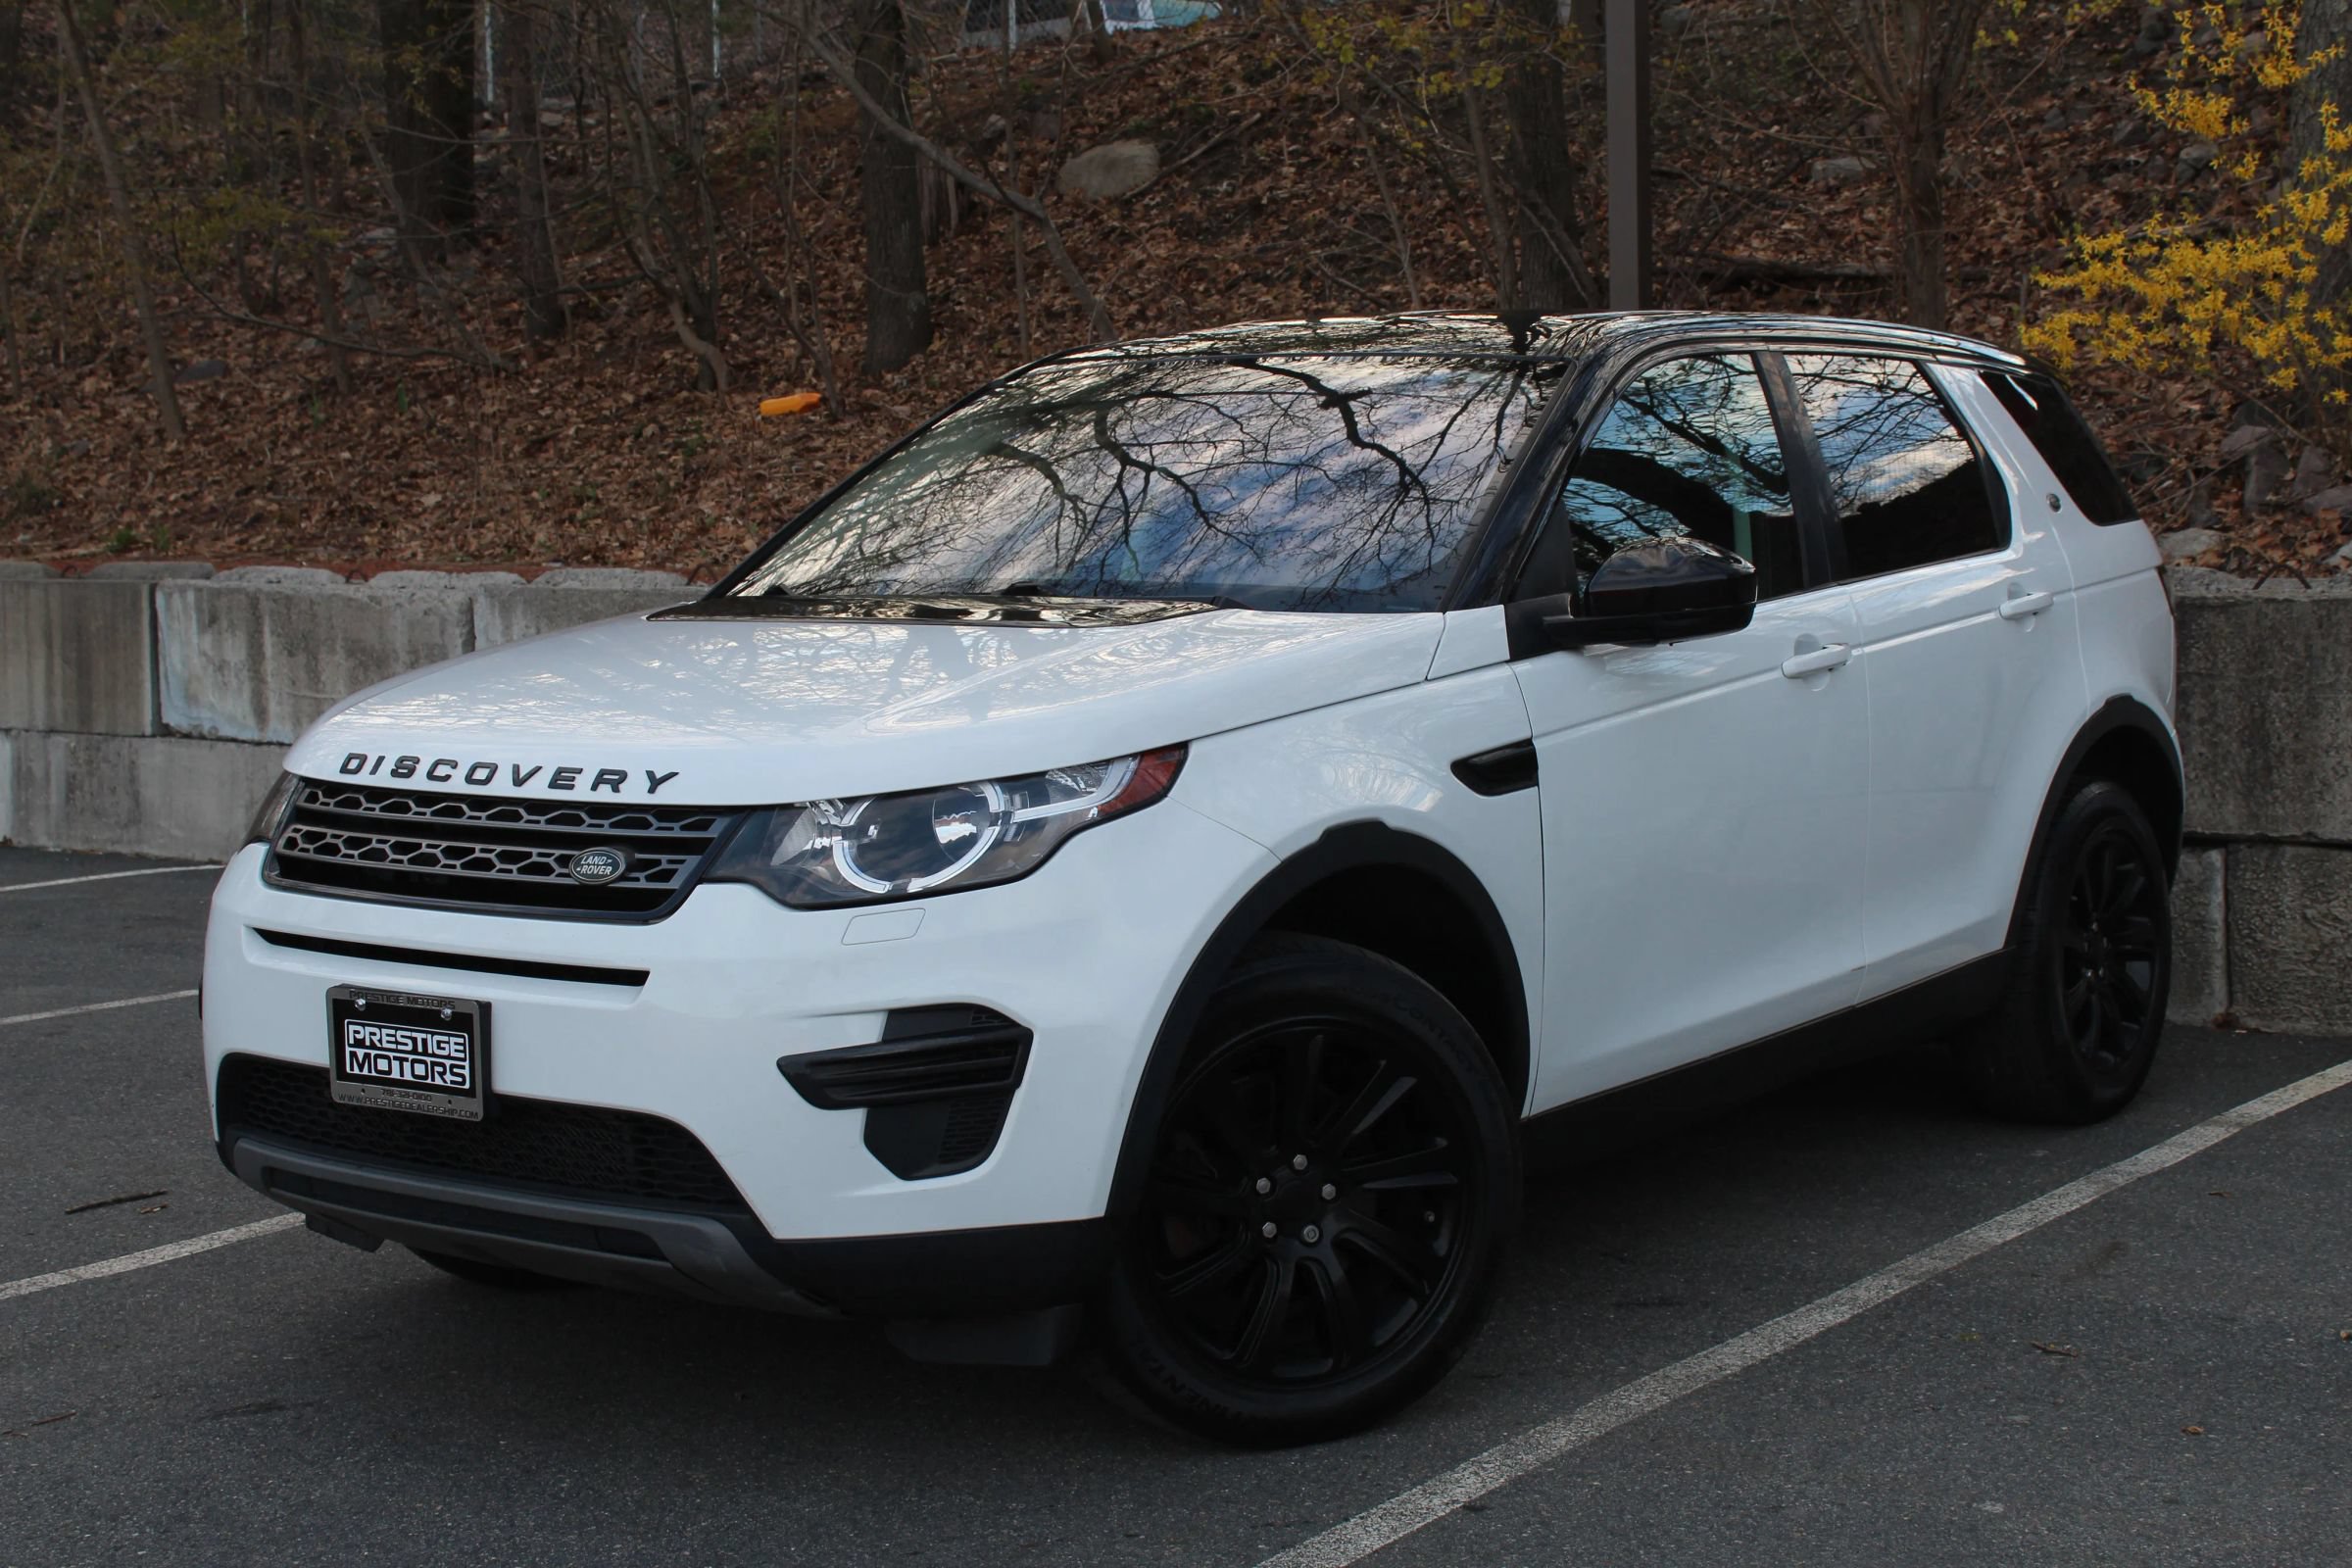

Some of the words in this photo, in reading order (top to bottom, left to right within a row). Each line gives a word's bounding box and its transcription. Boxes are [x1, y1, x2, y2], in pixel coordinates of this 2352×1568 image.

[339, 752, 680, 795] DISCOVERY
[580, 864, 612, 875] ROVER
[349, 990, 404, 1004] PRESTIGE
[407, 996, 456, 1010] MOTORS
[348, 1024, 466, 1058] PRESTIGE
[349, 1050, 466, 1087] MOTORS
[338, 1092, 479, 1119] WWW.PRESTIGEDEALERSHIP.COM
